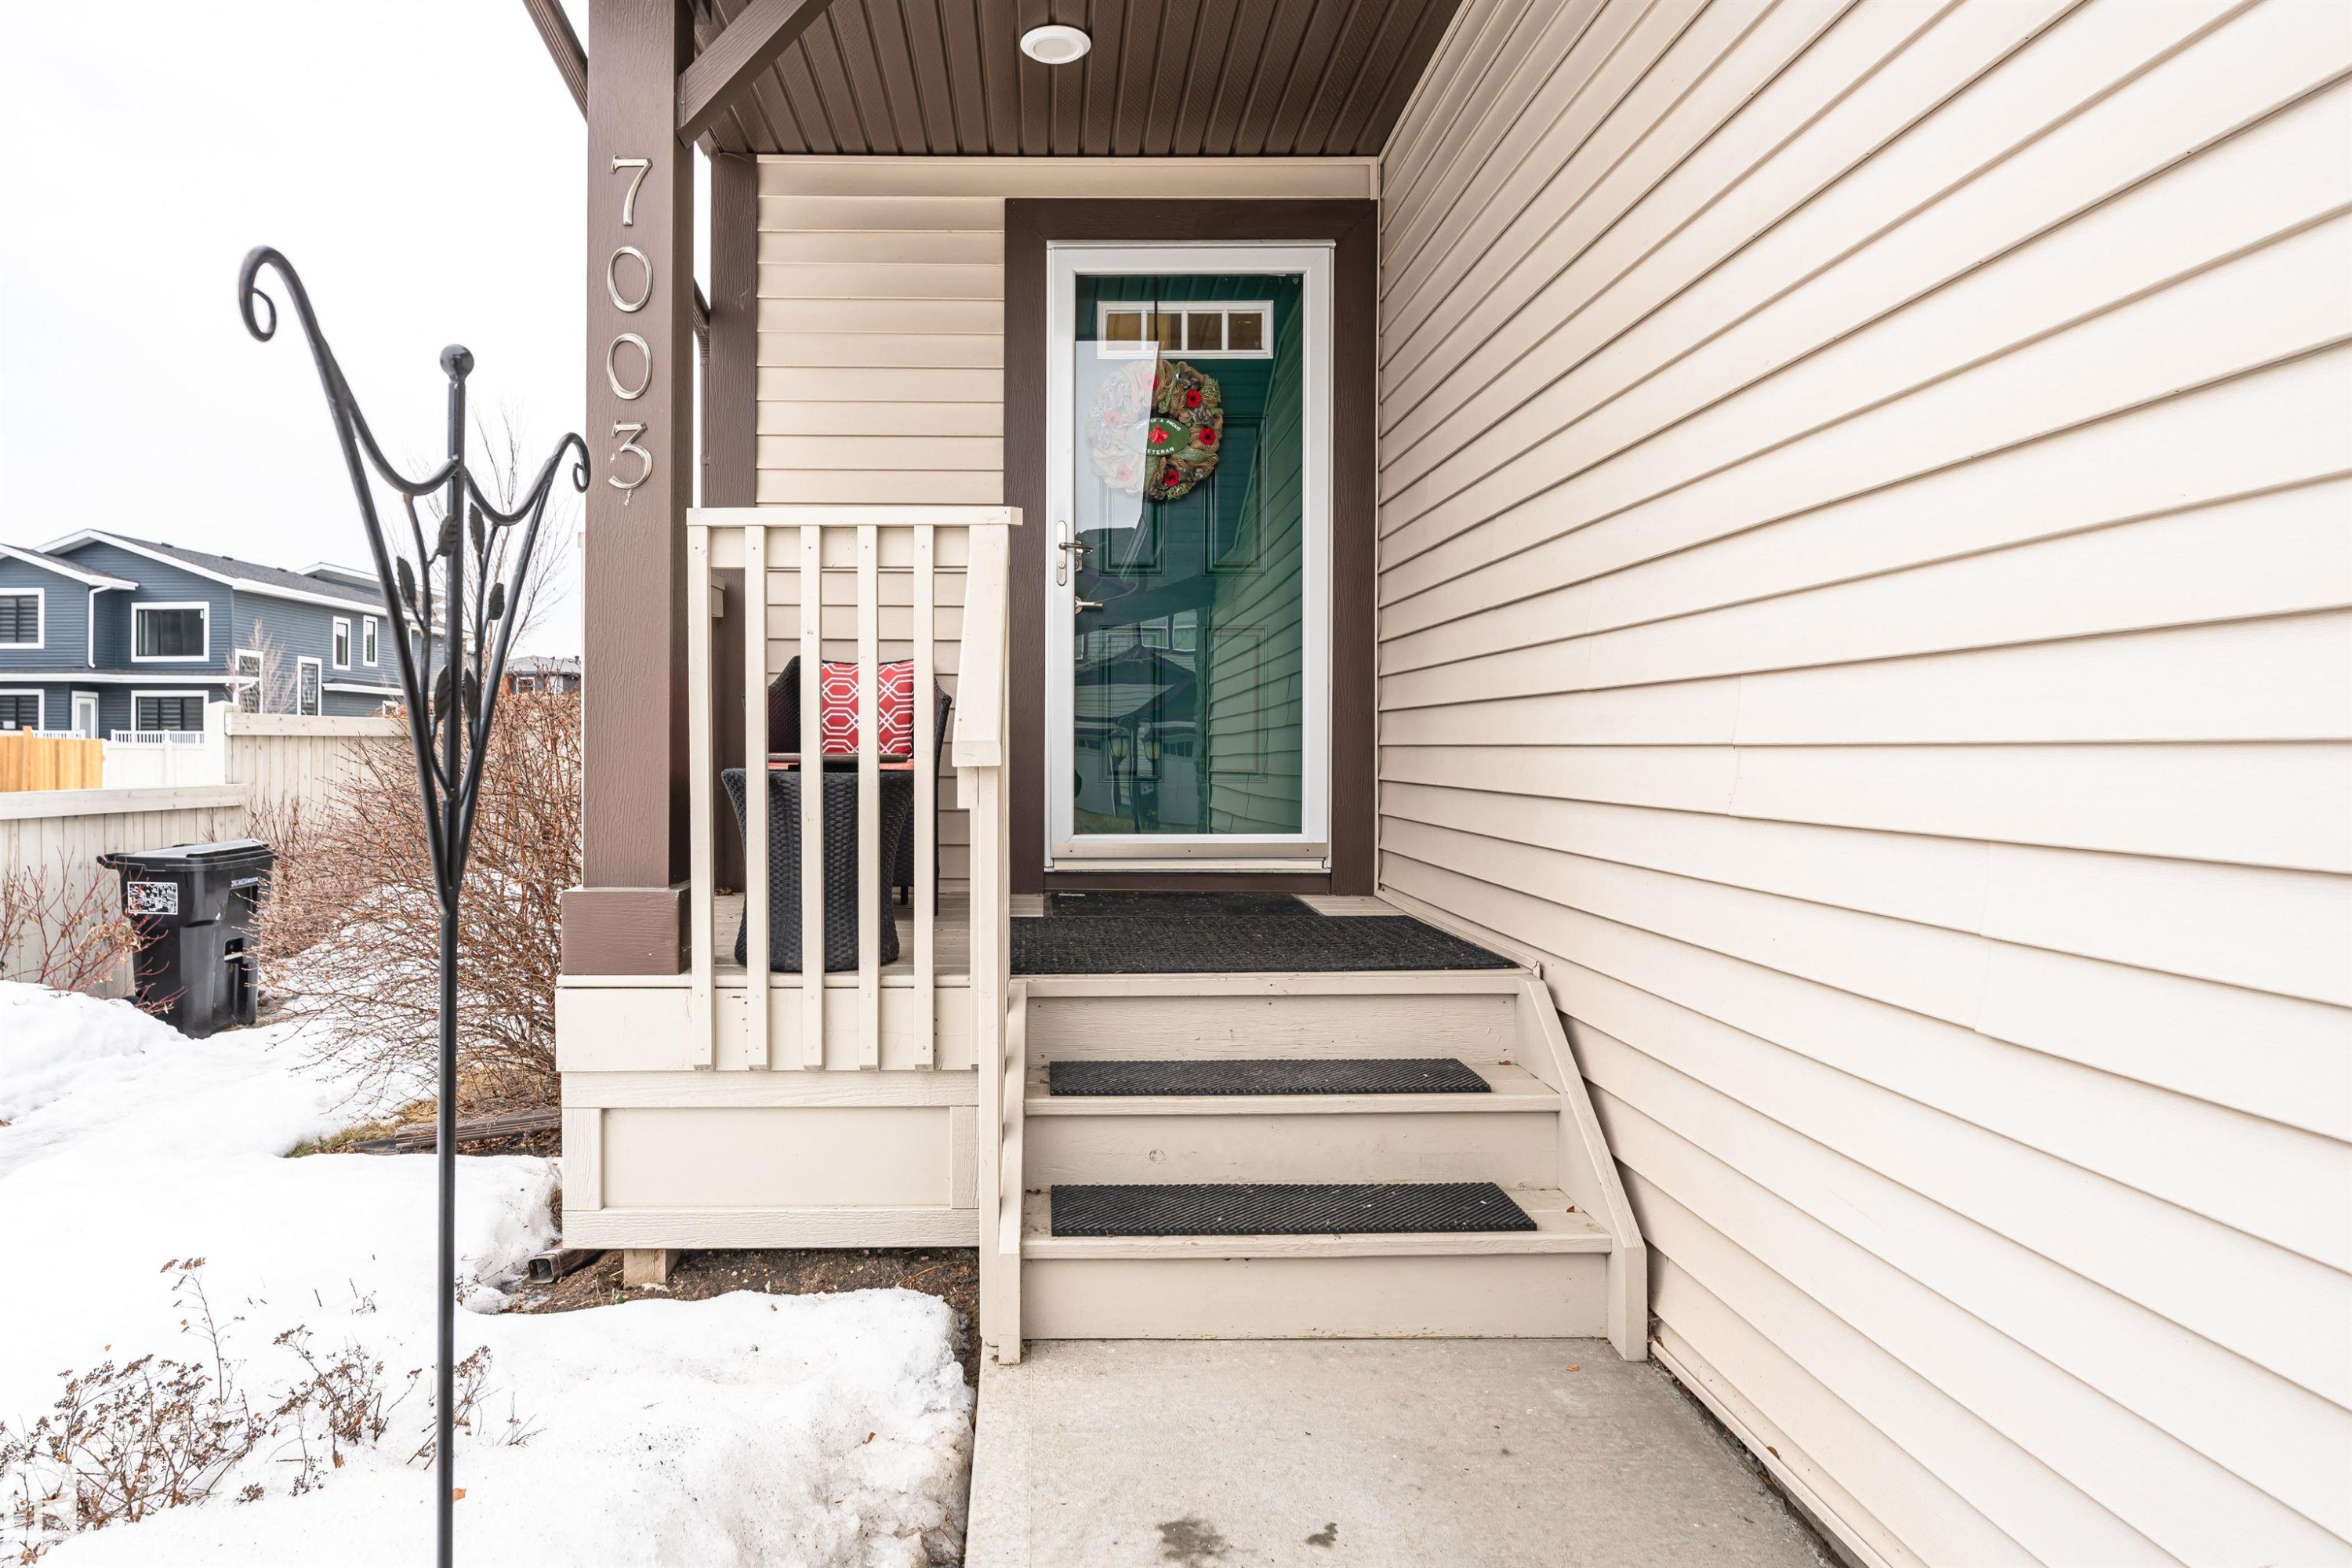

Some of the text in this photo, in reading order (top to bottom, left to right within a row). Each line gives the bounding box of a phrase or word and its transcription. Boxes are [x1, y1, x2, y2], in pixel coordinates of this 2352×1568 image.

[607, 155, 653, 489] 7003
[1166, 419, 1181, 431] PROUD
[1143, 446, 1174, 455] VETERAN
